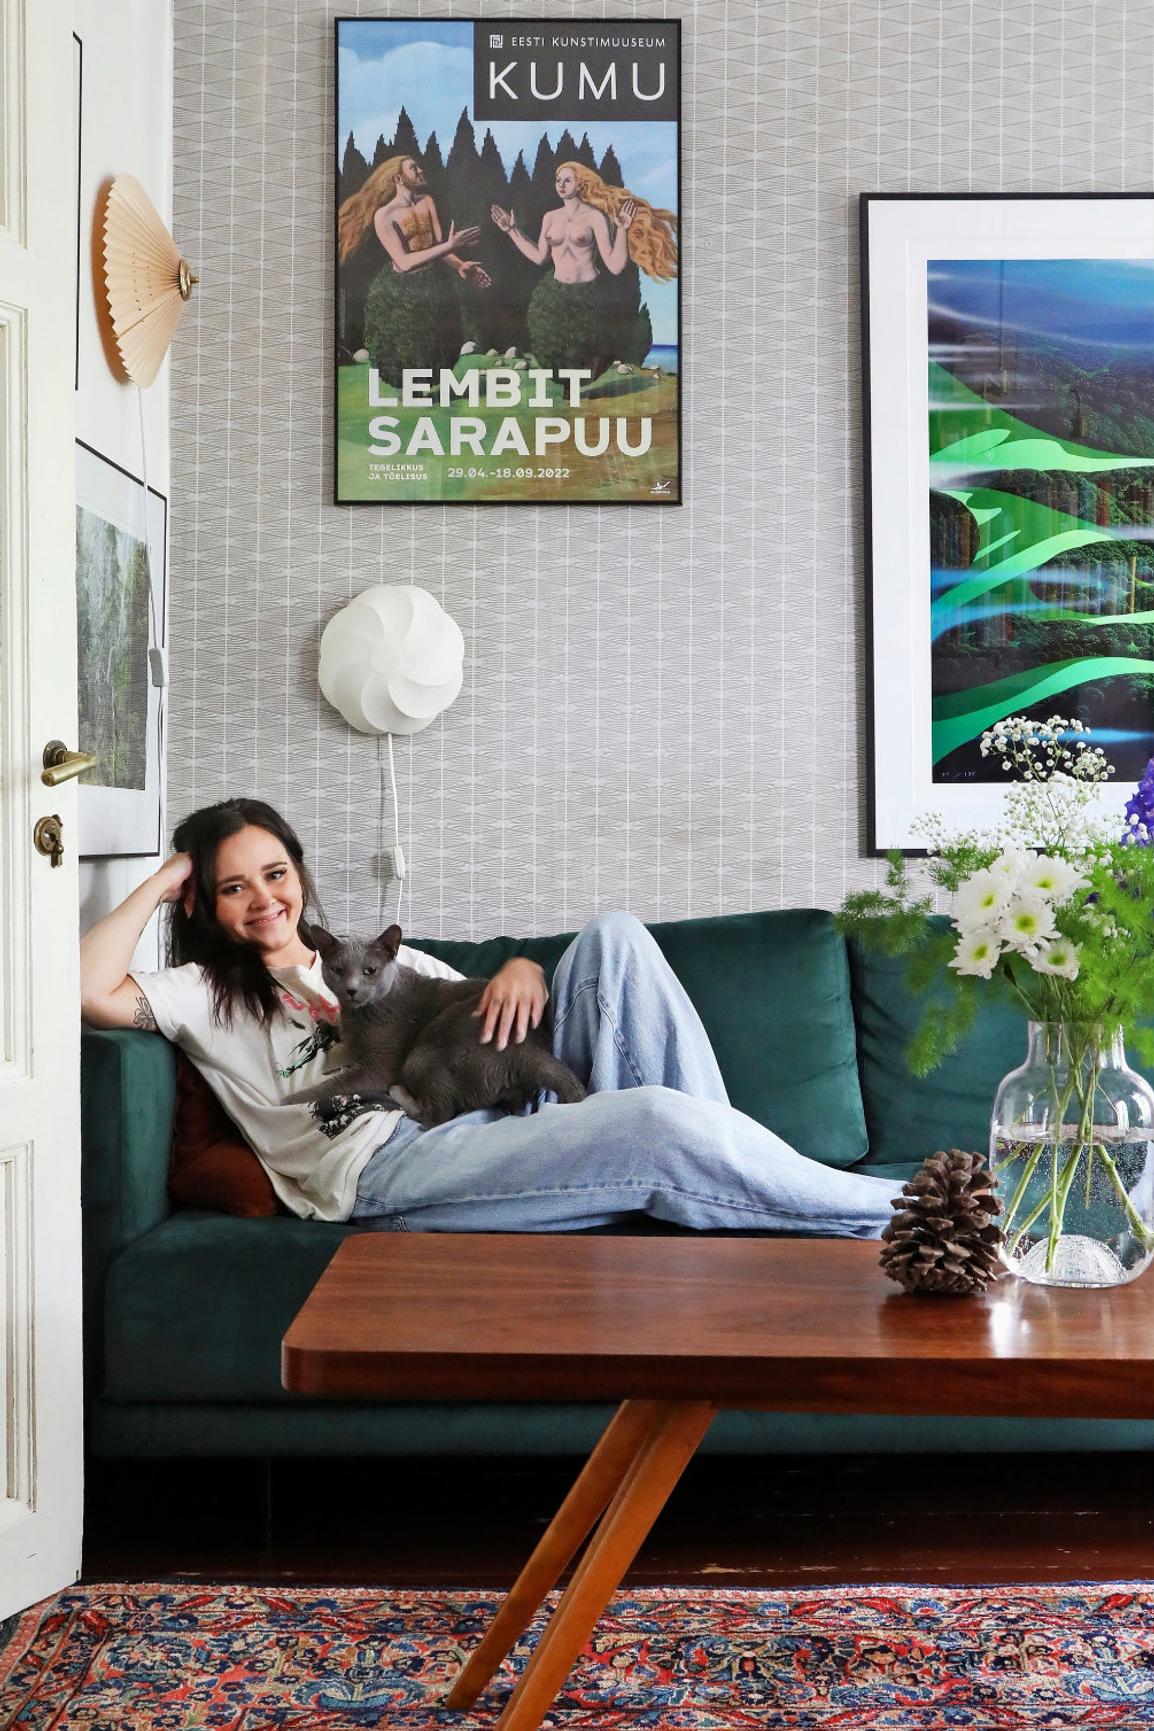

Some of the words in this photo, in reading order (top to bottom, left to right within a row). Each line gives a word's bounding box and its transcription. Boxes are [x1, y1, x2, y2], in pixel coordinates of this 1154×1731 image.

[511, 36, 545, 47] EESTI
[552, 36, 666, 48] KUNSTIMUUSEUM
[489, 61, 665, 101] KUMU
[368, 368, 592, 408] LEMBIT
[367, 416, 653, 458] SARAPUU
[448, 467, 570, 479] 29.04.-18.09.2022
